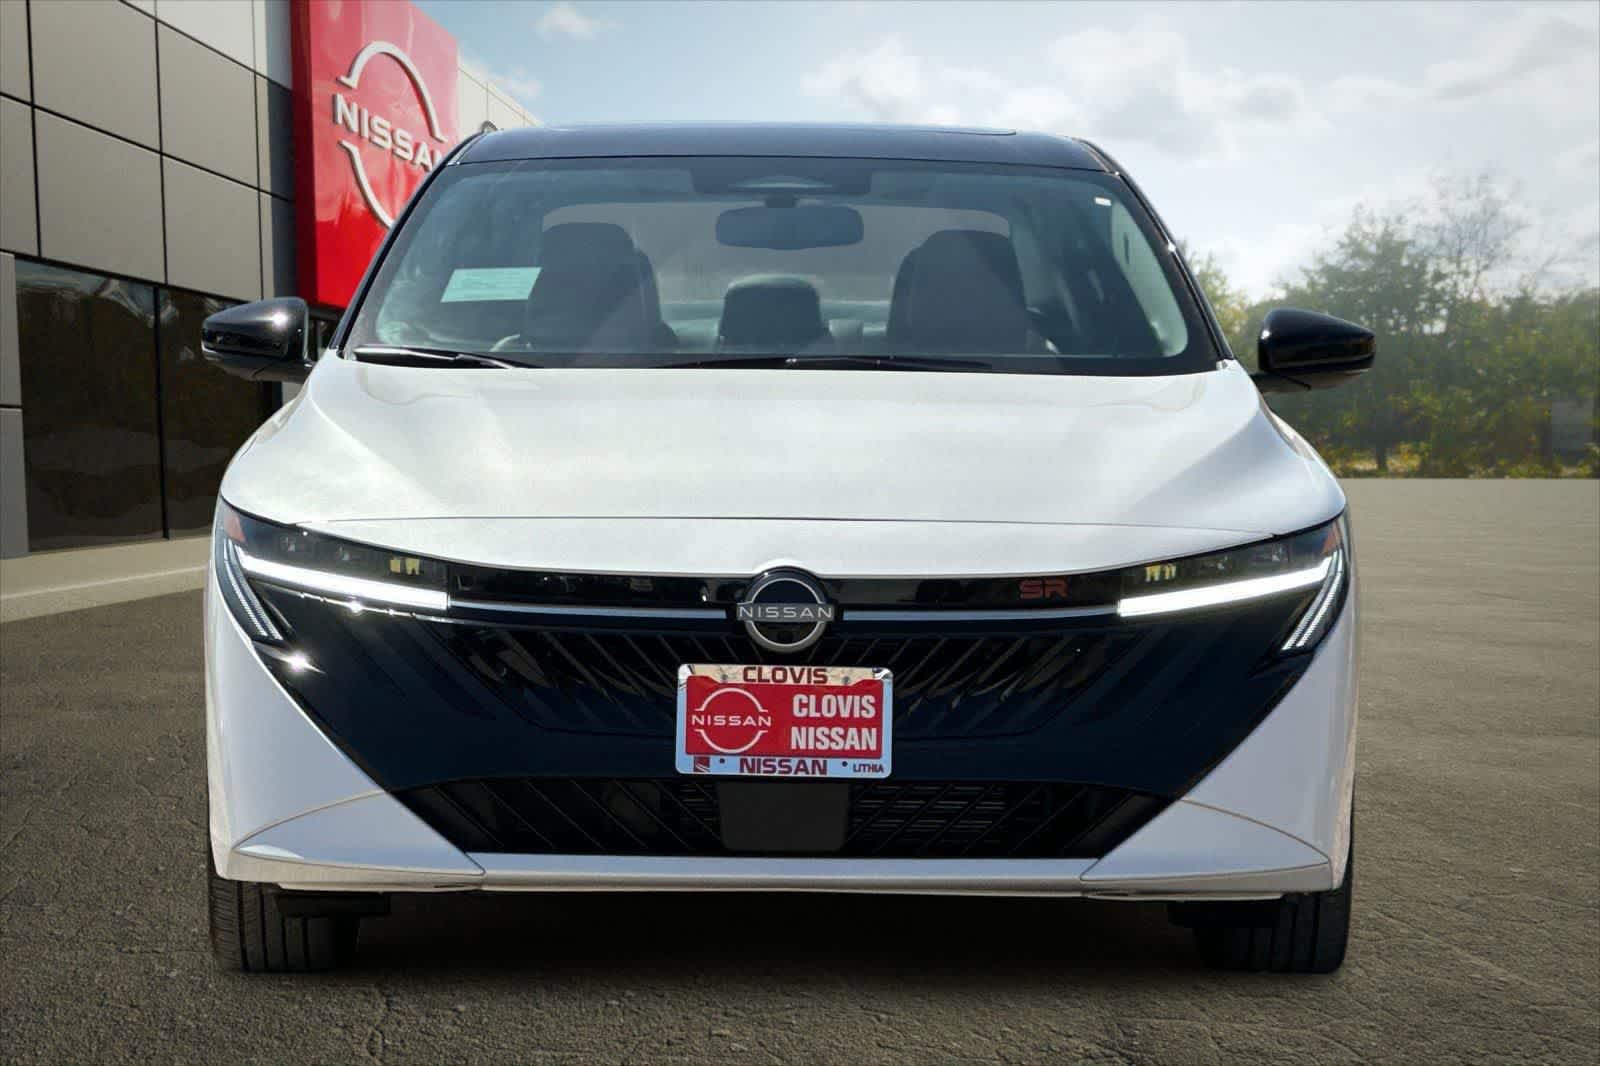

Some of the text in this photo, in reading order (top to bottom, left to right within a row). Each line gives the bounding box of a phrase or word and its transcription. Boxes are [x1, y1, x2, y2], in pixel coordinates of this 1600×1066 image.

[1020, 581, 1068, 599] SR
[739, 606, 832, 619] NISSAN
[743, 667, 828, 684] CLOVIS
[792, 694, 876, 719] CLOVIS
[691, 715, 772, 727] NISSAN
[790, 727, 877, 751] NISSAN
[739, 758, 828, 776] NISSAN
[852, 762, 884, 773] LITHIA
